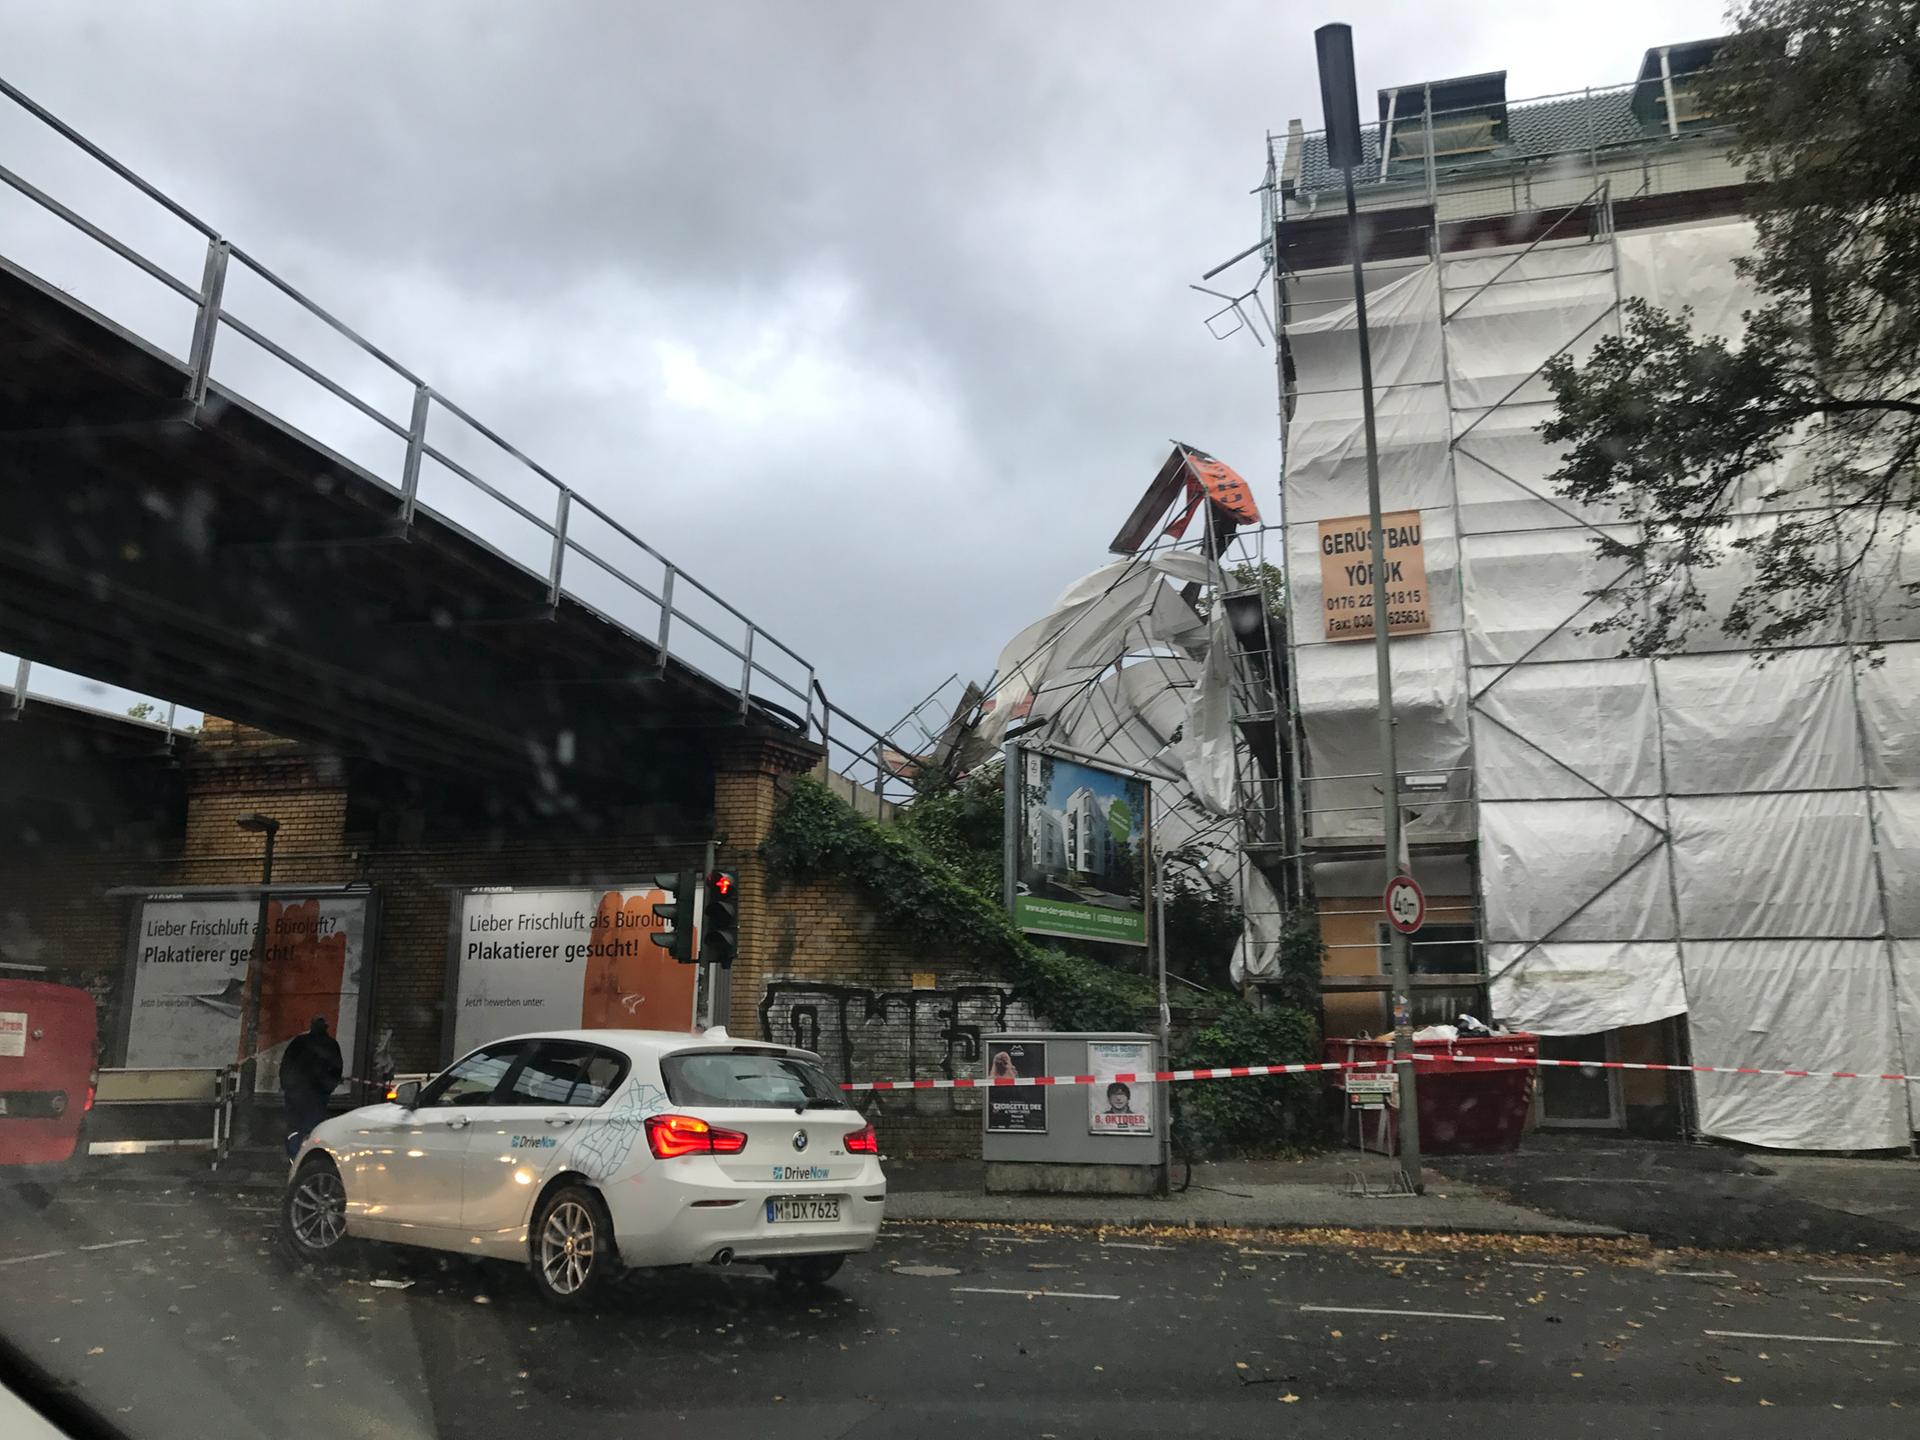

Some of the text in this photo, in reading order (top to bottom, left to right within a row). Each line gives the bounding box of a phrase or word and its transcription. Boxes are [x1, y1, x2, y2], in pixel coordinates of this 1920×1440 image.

[1322, 525, 1420, 555] GERÜBAU
[1327, 596, 1355, 610] 0176
[1329, 618, 1351, 631] Fax:
[1354, 614, 1373, 628] 030
[147, 917, 337, 937] Lieber Frischluft as Büroluft?
[470, 911, 675, 932] Lieber Frischluft als Bürolu
[144, 945, 296, 966] Plakatierer gescht!
[468, 939, 638, 963] Plakatierer gesucht!
[484, 996, 521, 1007] bewerben
[1105, 1115, 1145, 1125] OKTOBER
[519, 1135, 557, 1148] DriveNow
[784, 1166, 829, 1179] DriveNow
[775, 1202, 784, 1219] M
